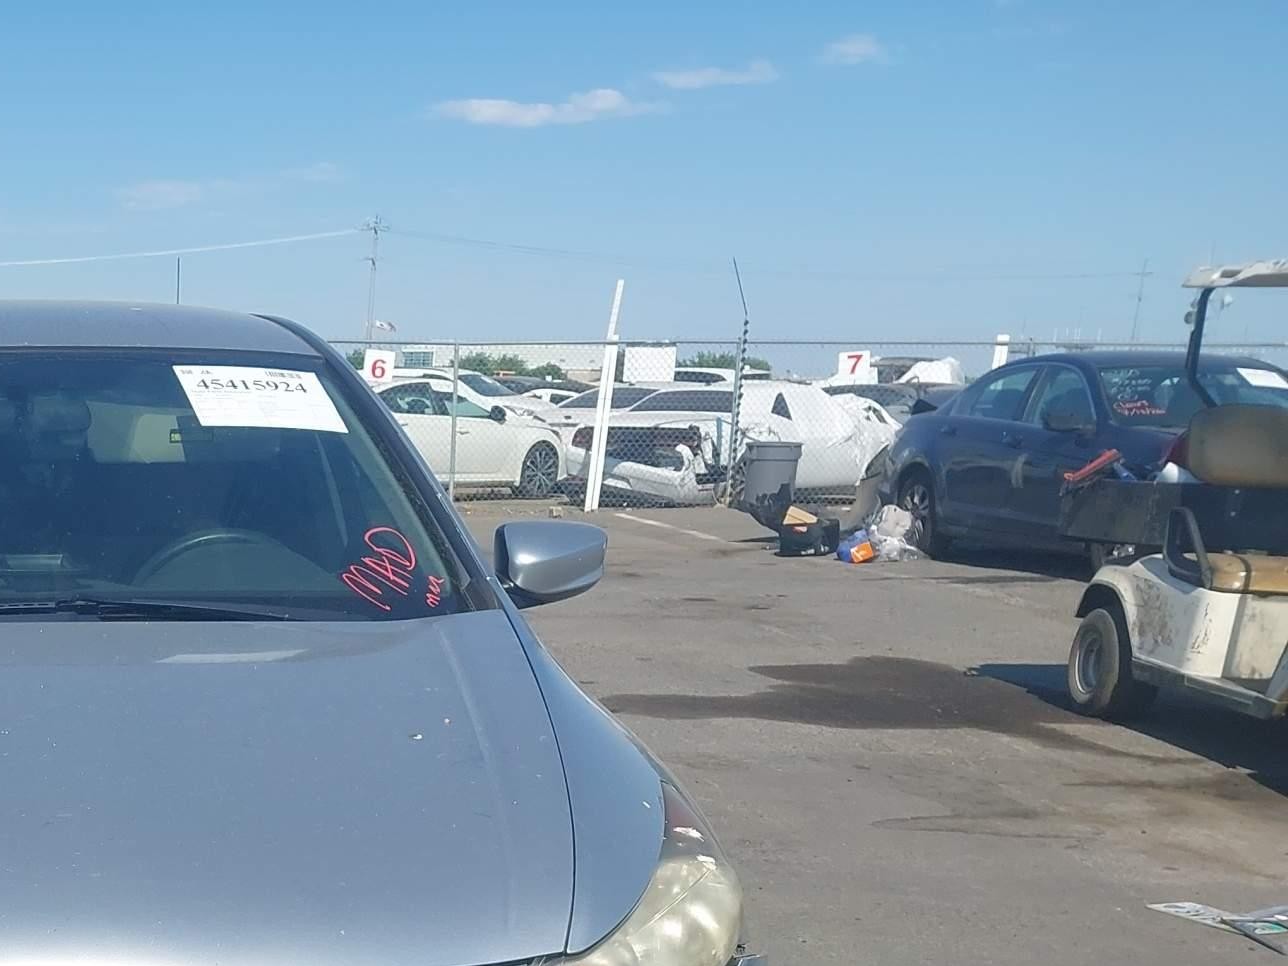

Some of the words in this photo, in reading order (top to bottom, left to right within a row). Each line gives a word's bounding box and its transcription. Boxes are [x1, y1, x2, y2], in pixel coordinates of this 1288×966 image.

[371, 359, 387, 378] 6
[847, 354, 864, 375] 7
[196, 378, 308, 394] 45415924
